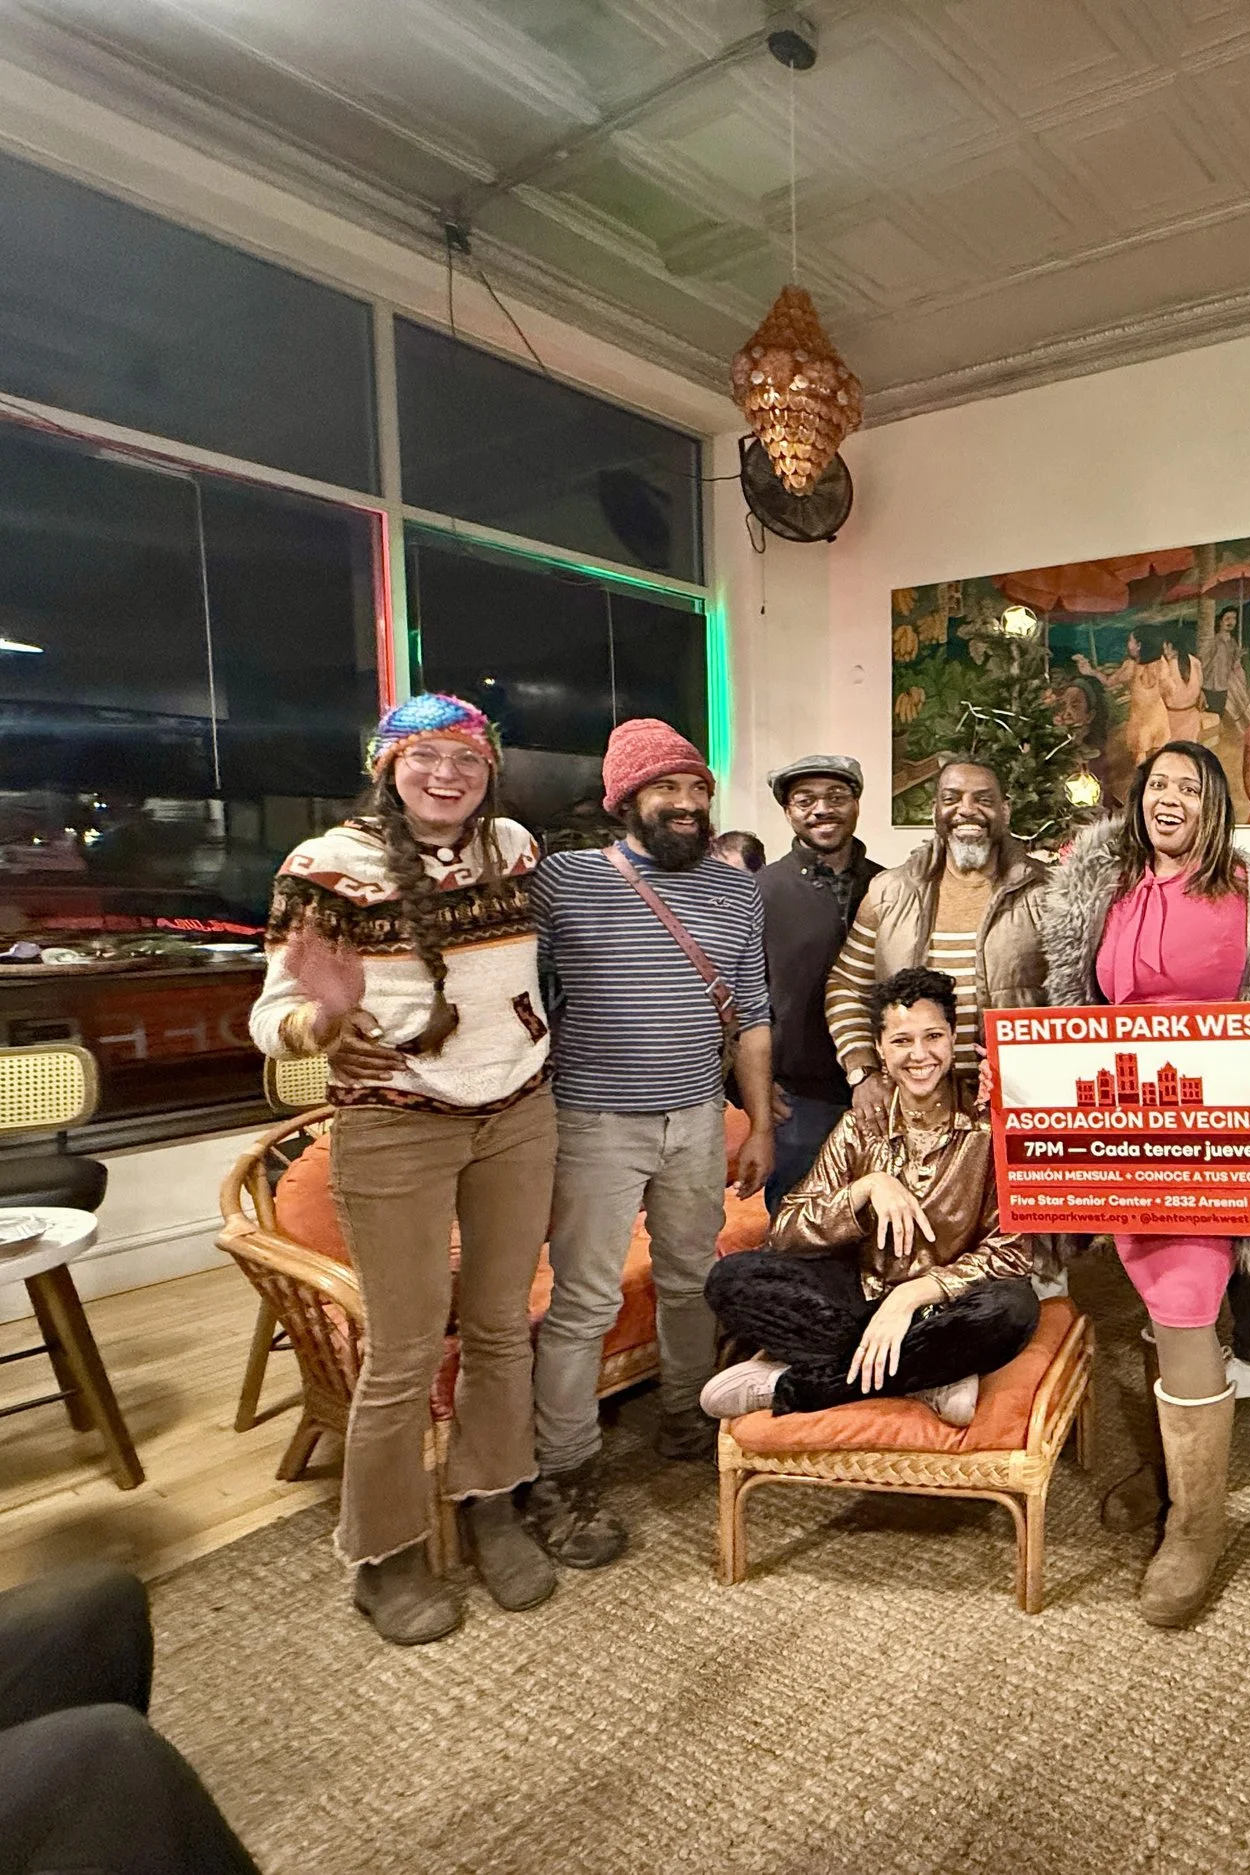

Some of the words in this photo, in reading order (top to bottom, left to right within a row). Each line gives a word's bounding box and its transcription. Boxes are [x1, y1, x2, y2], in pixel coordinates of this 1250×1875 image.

[996, 1017, 1108, 1041] BENTON
[1116, 1015, 1190, 1038] PARK
[1005, 1107, 1143, 1129] ASOCIACIÓN
[1149, 1111, 1177, 1129] DE
[1024, 1141, 1064, 1157] 7PM
[1090, 1141, 1140, 1157] Cada
[1144, 1141, 1201, 1157] tercer
[1008, 1167, 1062, 1182] REUNIÓN
[1065, 1169, 1123, 1182] MENSUAL
[1134, 1170, 1191, 1183] CONOCE
[1192, 1171, 1204, 1182] A
[1204, 1171, 1228, 1183] TUS
[1010, 1194, 1035, 1207] Five
[1038, 1194, 1065, 1207] Star
[1068, 1194, 1107, 1207] Senior
[1111, 1195, 1153, 1208] Center
[1164, 1195, 1197, 1208] 2832
[1198, 1195, 1249, 1208] Arsenal
[1011, 1211, 1129, 1225] bentonparkwest.org
[1139, 1211, 1250, 1226] @bentonparkwest
